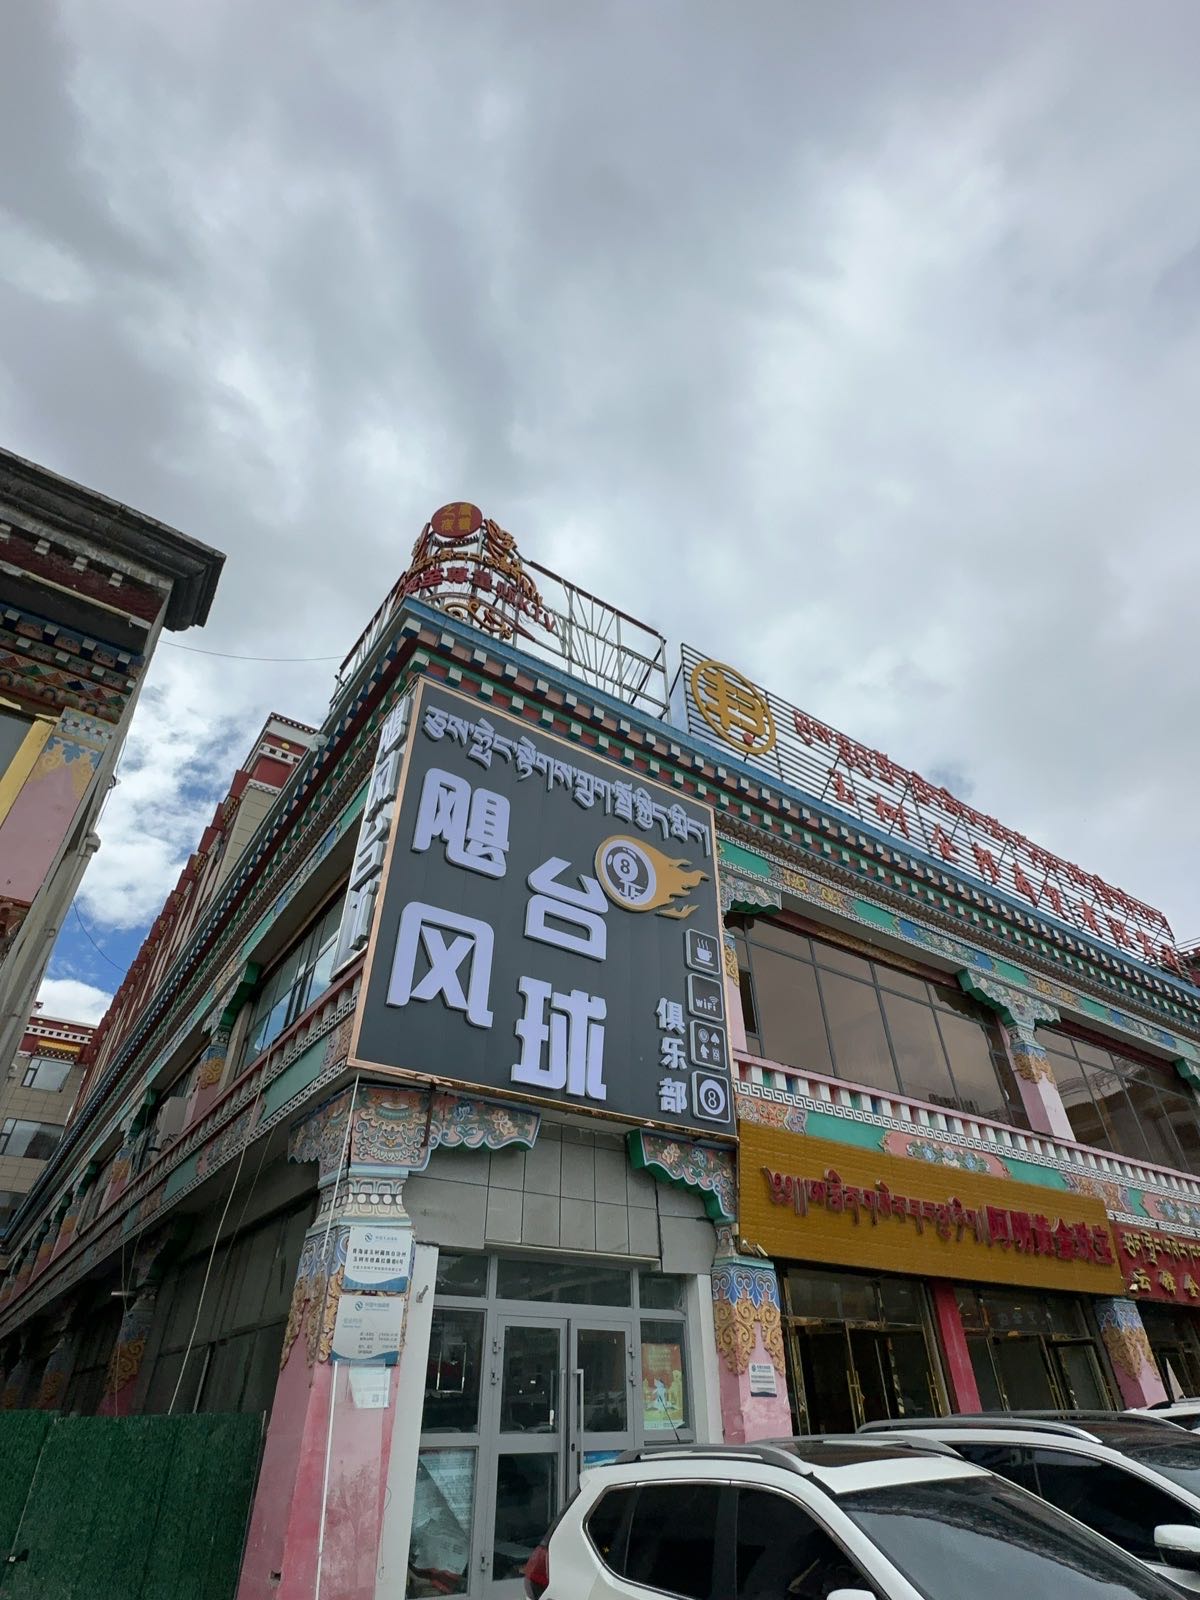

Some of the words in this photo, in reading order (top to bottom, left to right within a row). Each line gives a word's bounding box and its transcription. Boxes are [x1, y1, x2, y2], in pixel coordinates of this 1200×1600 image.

[619, 857, 632, 875] 8
[656, 997, 689, 1116] 俱乐部
[706, 1090, 720, 1108] 8
